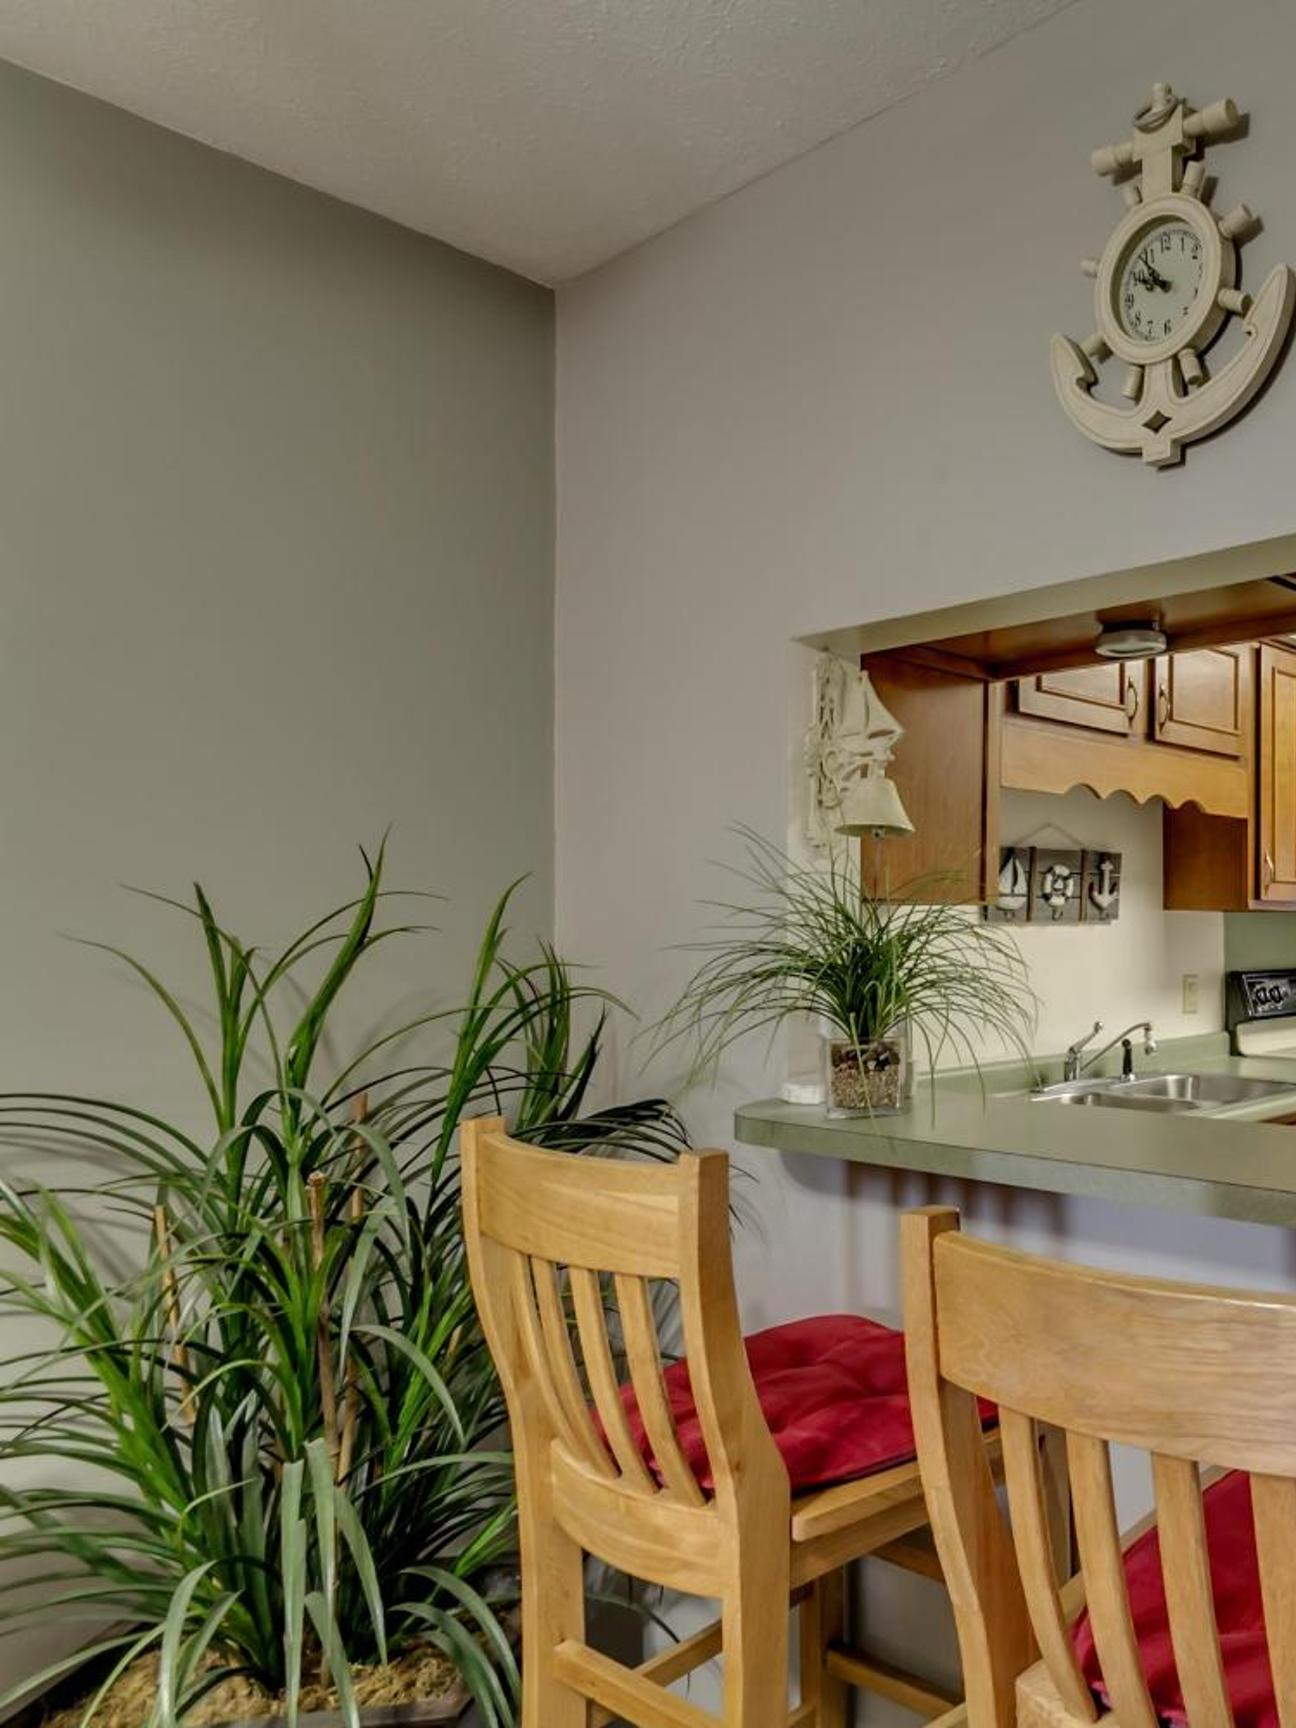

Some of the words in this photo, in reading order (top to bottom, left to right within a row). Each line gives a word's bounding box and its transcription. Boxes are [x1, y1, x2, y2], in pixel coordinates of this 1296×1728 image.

[1160, 231, 1171, 253] 12
[1147, 320, 1154, 336] 7
[1163, 320, 1172, 336] 6
